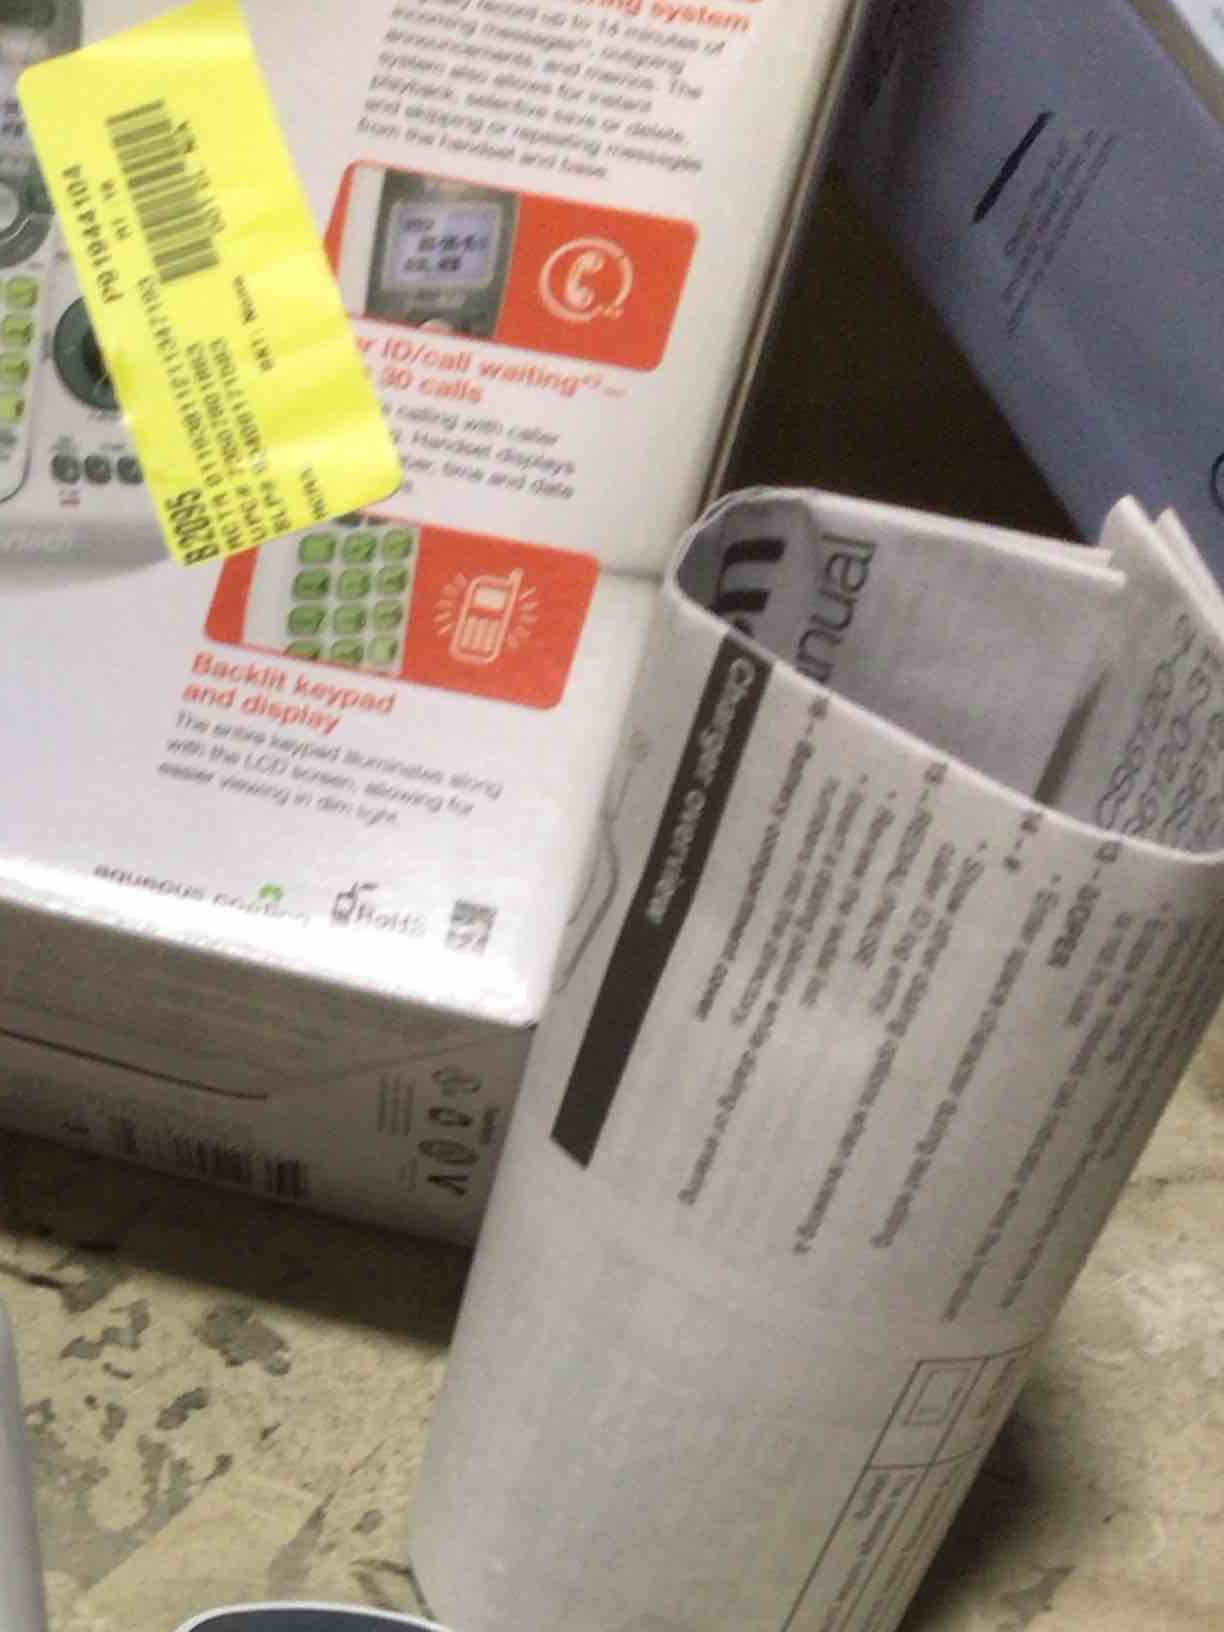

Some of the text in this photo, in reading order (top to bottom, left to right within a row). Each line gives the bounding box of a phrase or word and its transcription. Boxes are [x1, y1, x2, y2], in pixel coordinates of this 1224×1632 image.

[382, 337, 473, 374] ID/call
[418, 376, 484, 404] calls
[182, 681, 343, 736] and display
[192, 651, 397, 714] Backlit keypad
[176, 709, 210, 735] The
[268, 729, 342, 763] keypad
[448, 769, 505, 802] along
[209, 741, 241, 766] the
[243, 746, 290, 777] LCD
[446, 793, 475, 817] for
